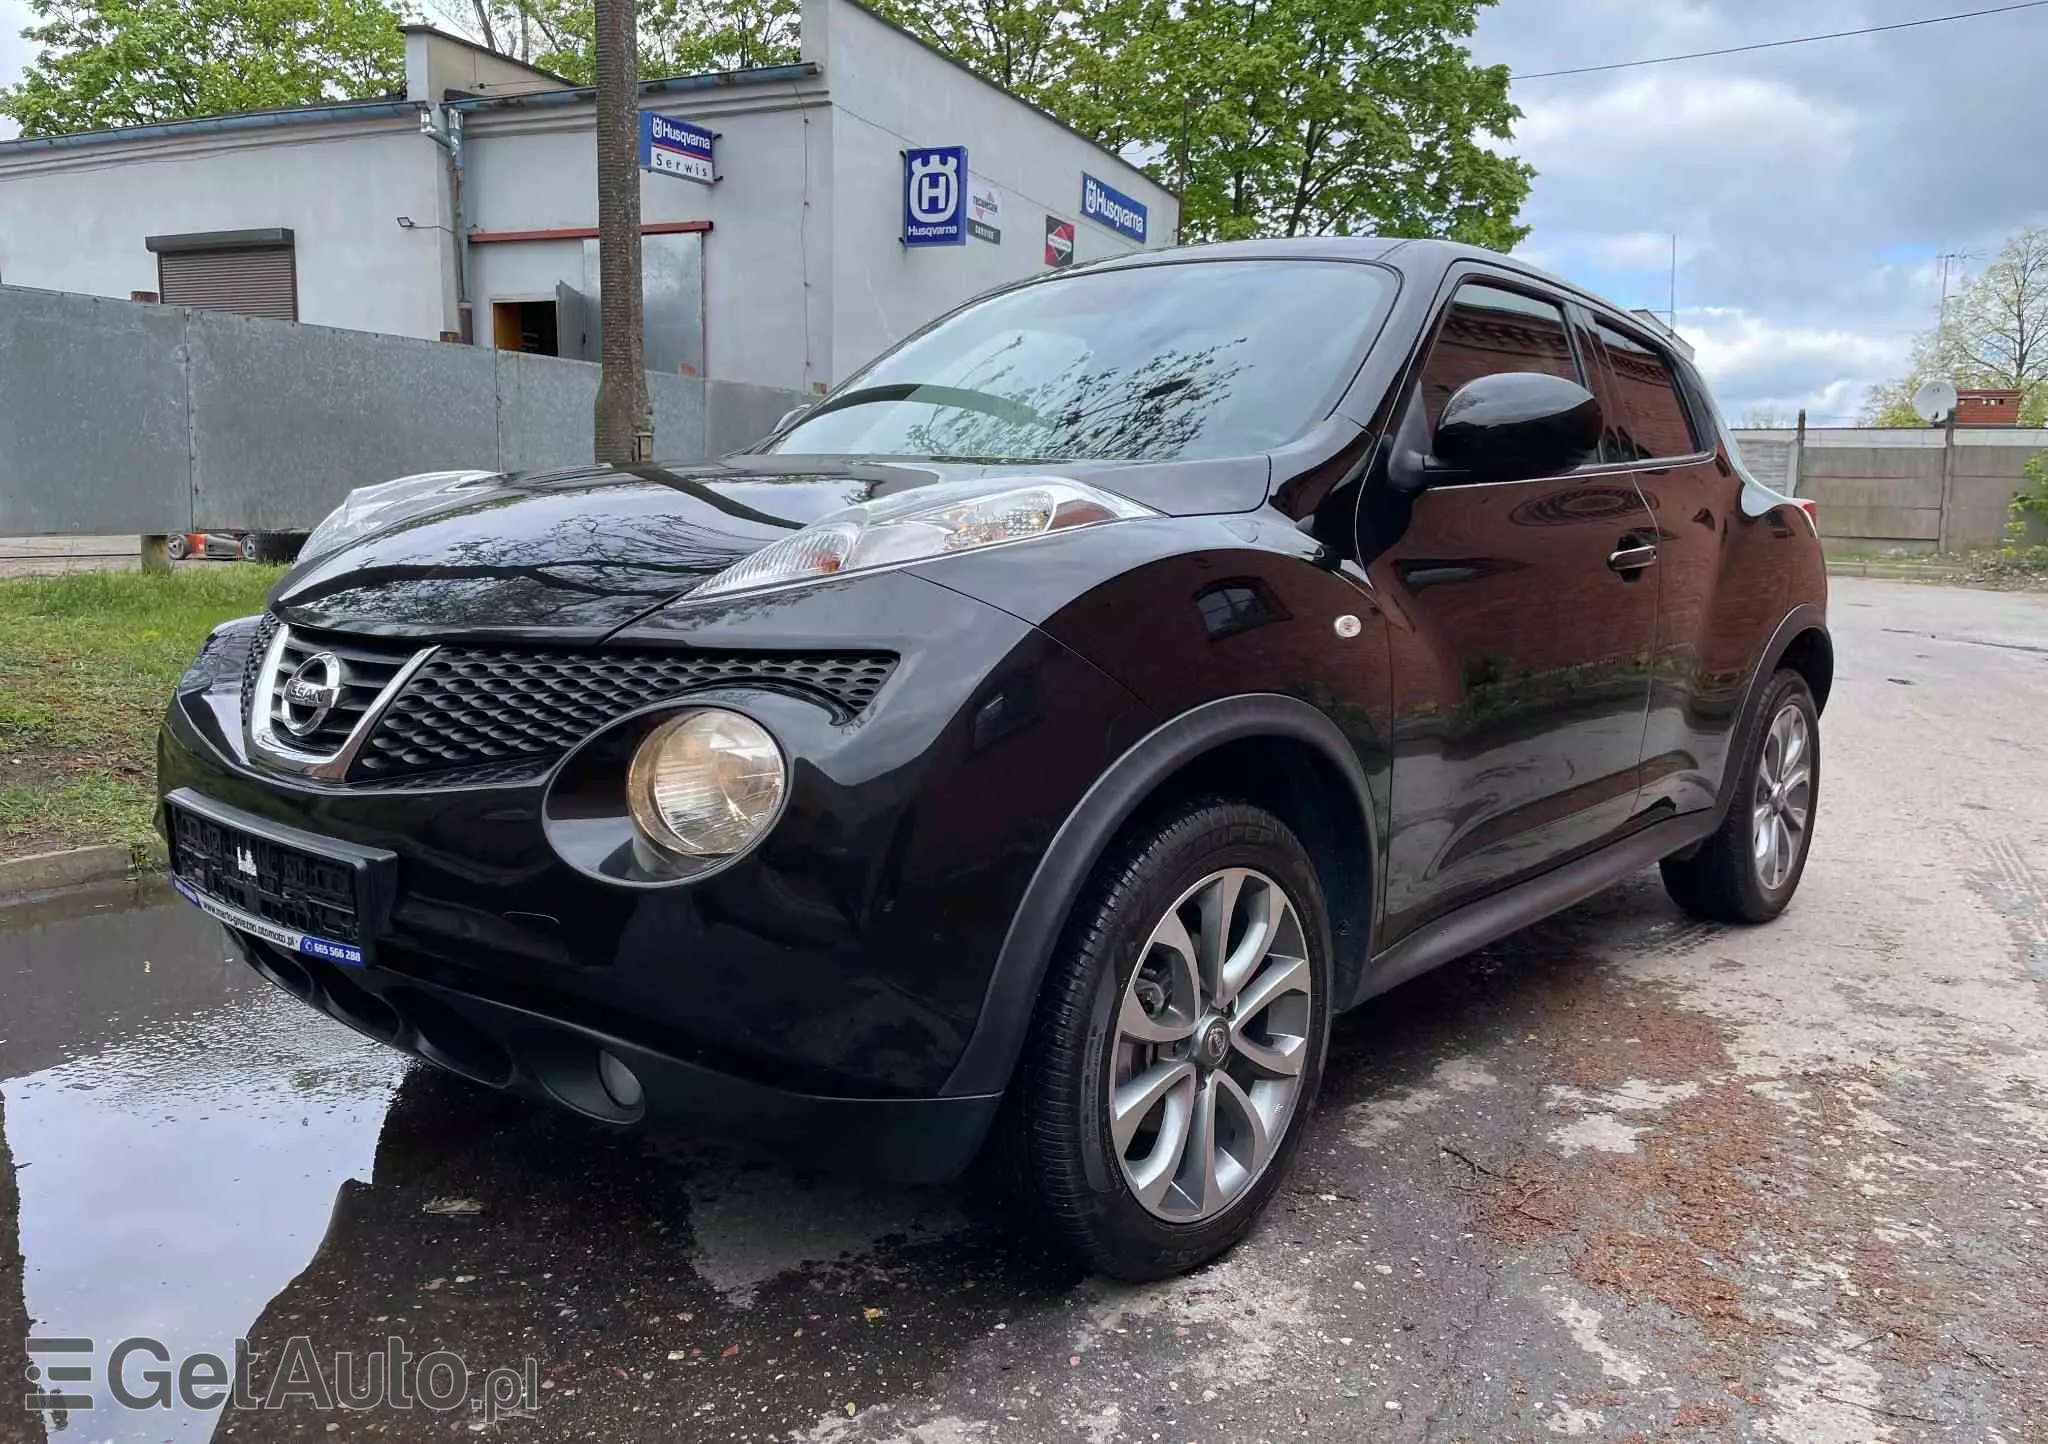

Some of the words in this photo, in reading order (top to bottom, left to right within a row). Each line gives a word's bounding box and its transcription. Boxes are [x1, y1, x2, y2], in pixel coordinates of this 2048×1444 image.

[663, 122, 710, 149] Husqvarna
[656, 153, 707, 177] Serwis
[1096, 188, 1144, 233] Husqvarna
[908, 225, 957, 237] Husqvarna
